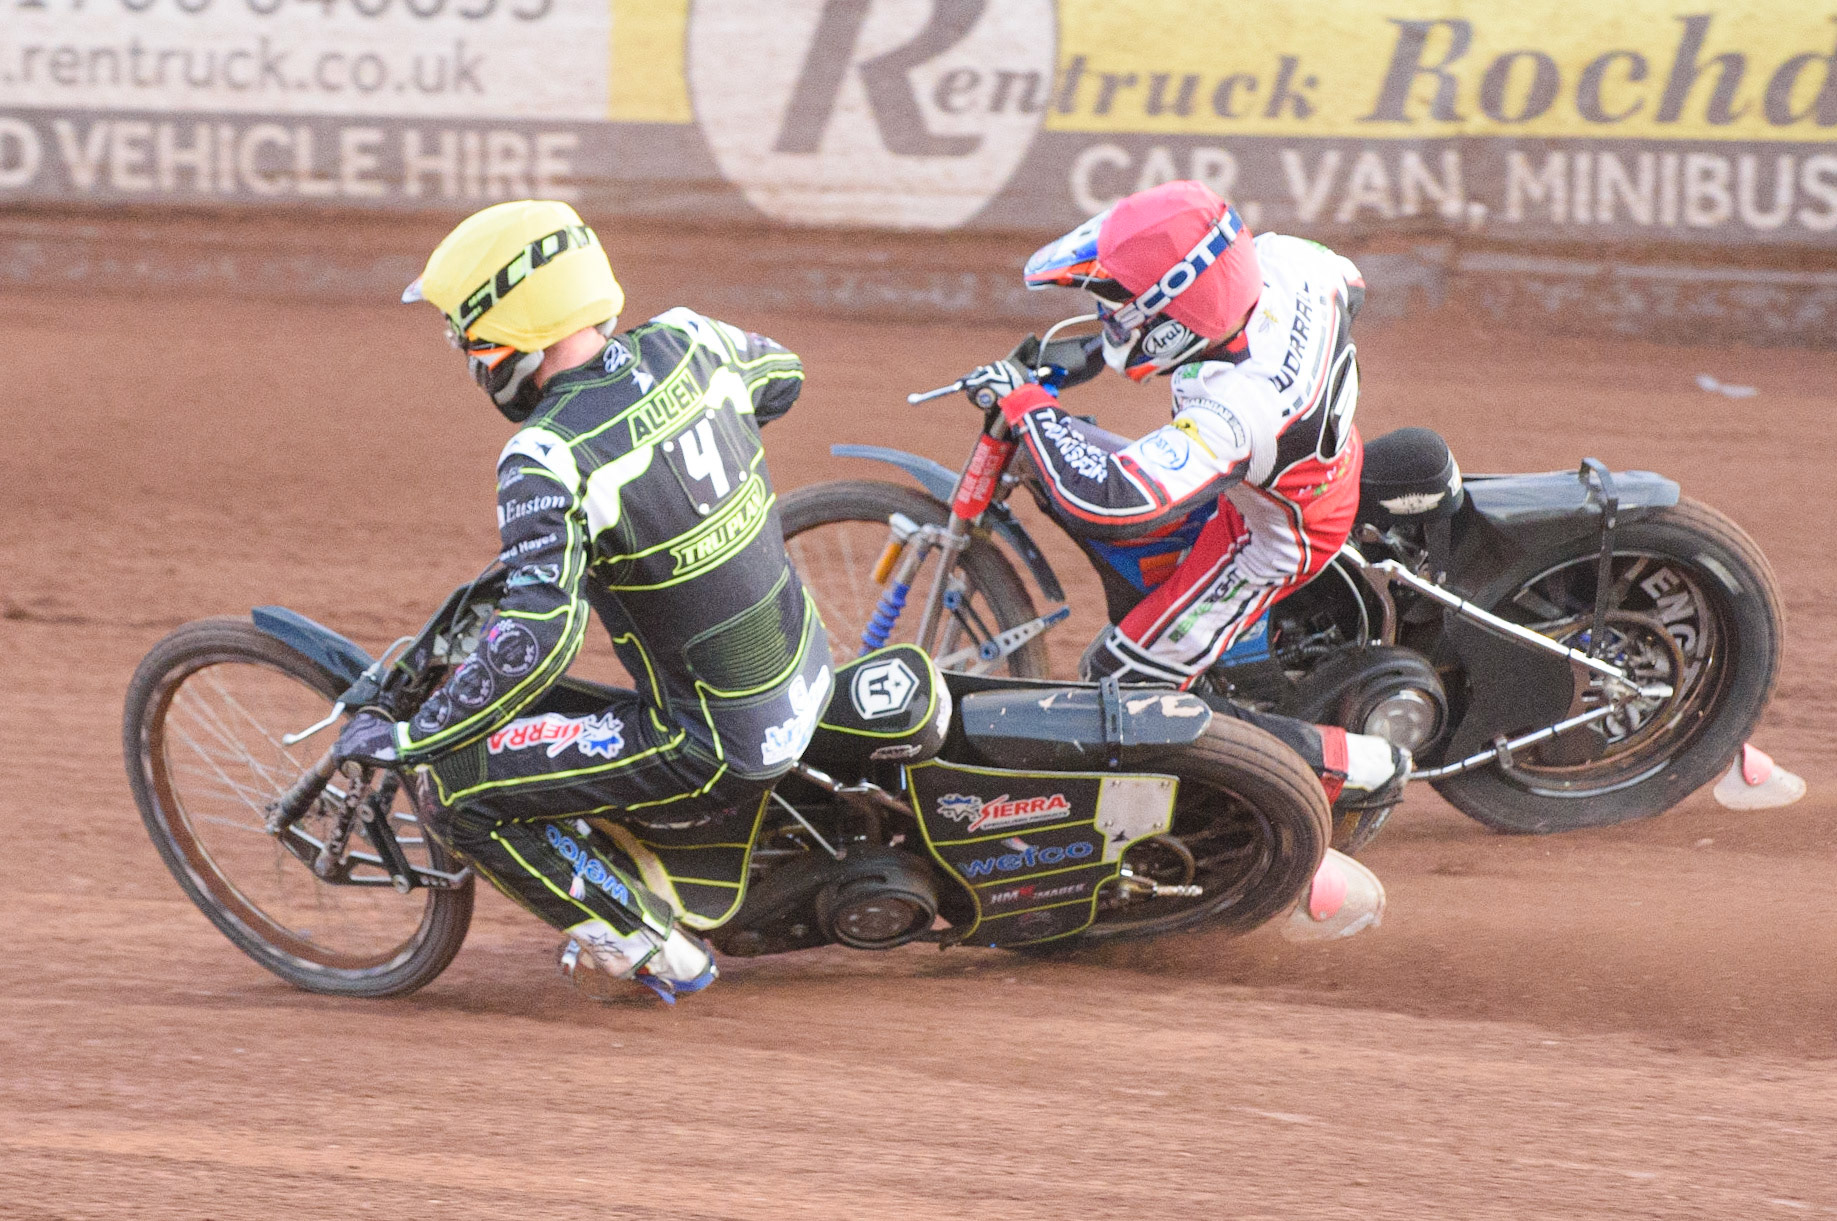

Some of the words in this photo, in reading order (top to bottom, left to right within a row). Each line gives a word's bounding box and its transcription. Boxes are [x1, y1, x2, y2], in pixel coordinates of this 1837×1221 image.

[53, 117, 386, 197] VEHICLE
[402, 129, 580, 199] HIRE
[1504, 150, 1837, 231] MINIBUS
[1116, 206, 1242, 330] SCOTT
[632, 371, 702, 441] ALLEN
[679, 417, 731, 499] 4
[506, 495, 566, 523] Euston
[490, 720, 584, 757] SIERRA
[968, 794, 1071, 832] SIERRA
[546, 824, 629, 907] wefco
[958, 840, 1094, 879] wefco
